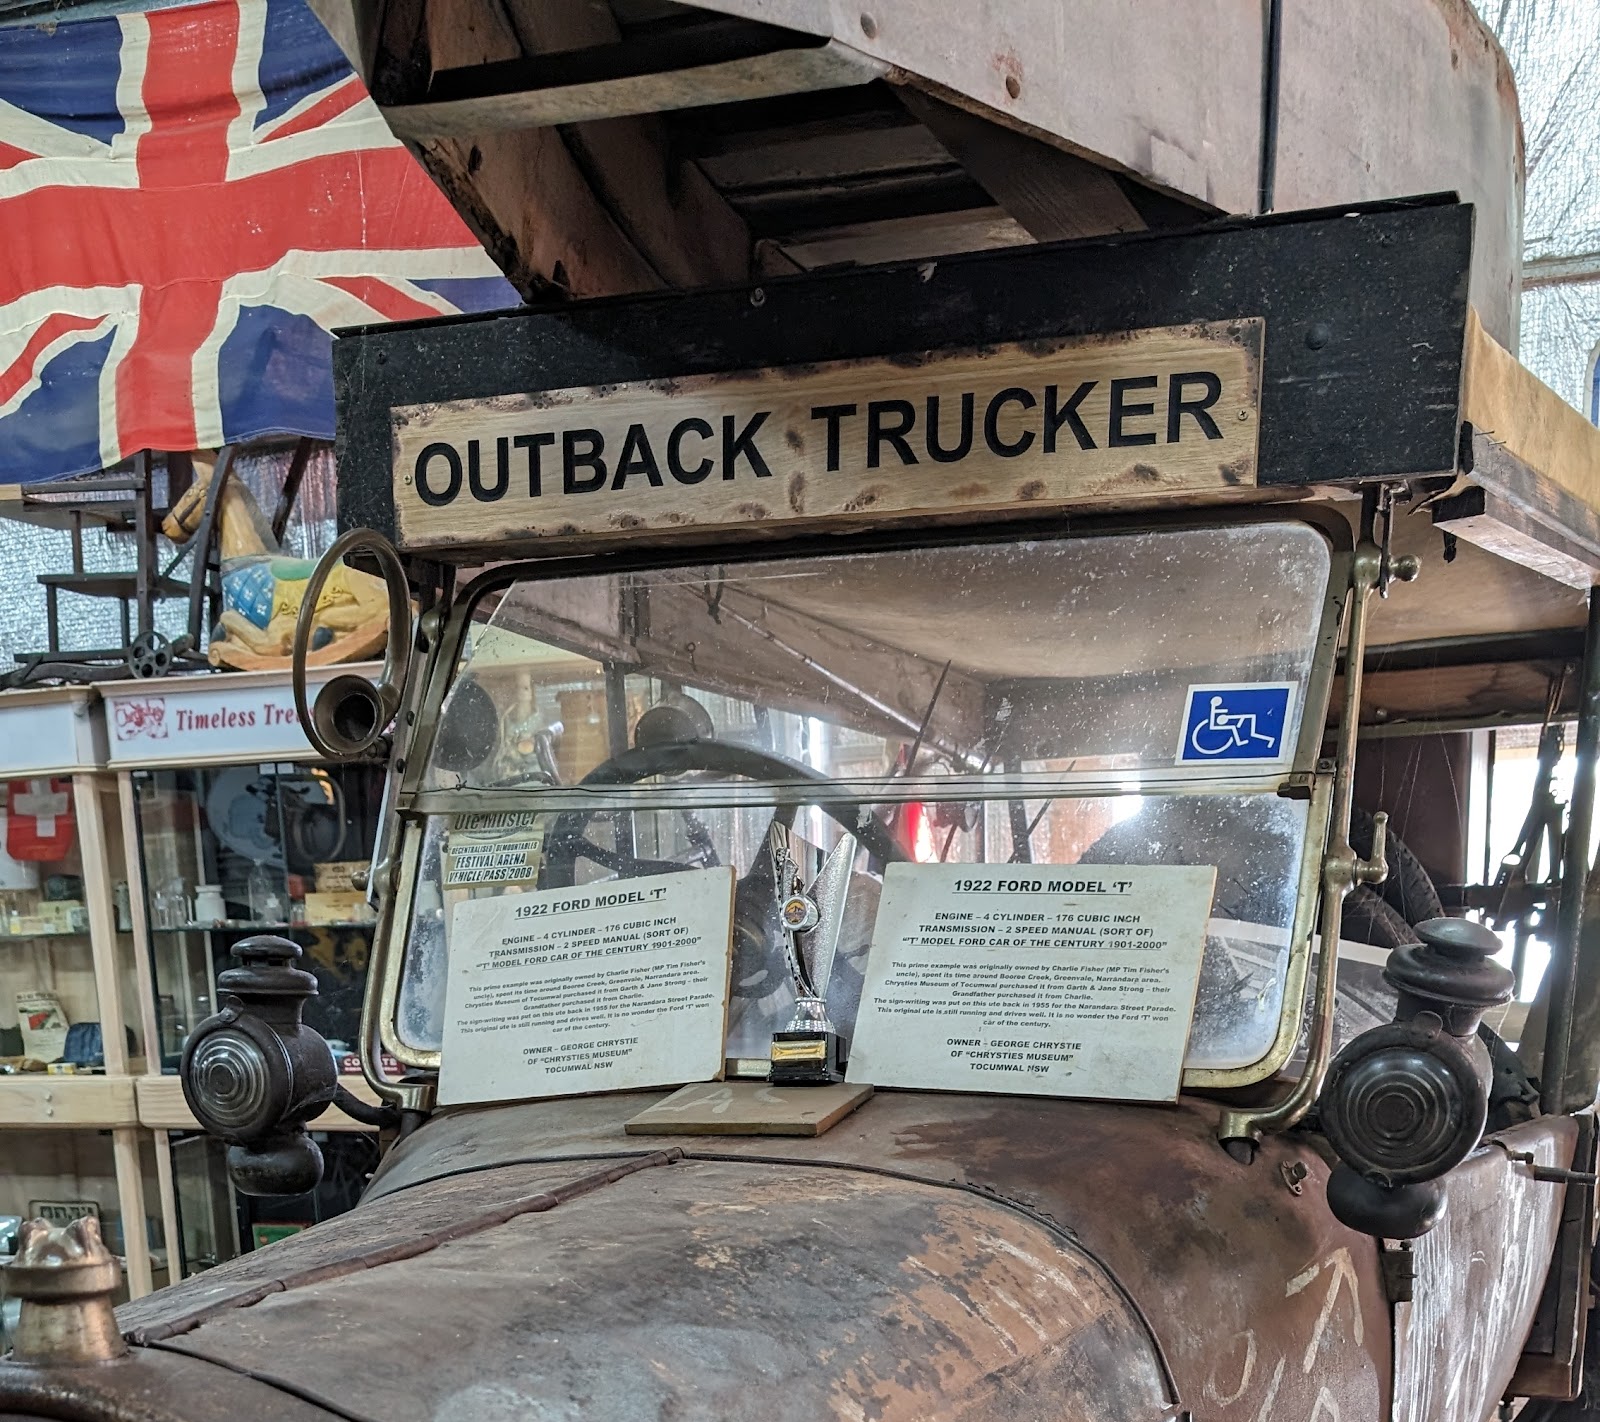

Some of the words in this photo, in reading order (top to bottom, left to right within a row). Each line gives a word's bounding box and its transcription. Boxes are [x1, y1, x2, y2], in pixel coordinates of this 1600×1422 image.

[414, 410, 773, 508] OUTBACK
[811, 371, 1225, 473] TRUCKER
[175, 707, 256, 731] Timeless
[456, 854, 495, 868] FESTIVAL
[497, 853, 526, 866] ARENA
[449, 870, 482, 882] VEHICLE
[483, 868, 507, 880] PASS
[508, 866, 533, 879] 2008
[953, 879, 993, 891] 1922
[997, 880, 1043, 892] FORD
[1047, 880, 1108, 893] MODEL
[515, 903, 548, 918] 1922
[552, 897, 591, 913] FORD
[595, 890, 646, 907] MODEL
[935, 912, 973, 920] ENGINE
[992, 913, 1045, 921] CYLINDER
[1055, 914, 1074, 922] 176
[1076, 914, 1112, 922] CUBIC
[1113, 914, 1140, 923] INCH
[501, 934, 535, 946] ENGINE
[550, 927, 596, 939] CYLINDER
[604, 923, 621, 932] 176
[622, 919, 652, 930] CUBIC
[653, 916, 676, 927] INCH
[918, 924, 995, 934] TRANSMISSION
[1013, 926, 1049, 934] SPEED
[1051, 926, 1097, 936] MANUAL
[1099, 927, 1133, 937] (SORT
[1135, 928, 1154, 937] OF)
[488, 943, 555, 959] TRANSMISSION
[563, 941, 569, 949] 2
[571, 938, 600, 948] SPEED
[602, 932, 642, 944] MANUAL
[642, 928, 672, 940] (SORT
[673, 926, 689, 936] OF)
[920, 936, 957, 945] MODEL
[958, 937, 987, 946] FORD
[988, 938, 1010, 946] CAR
[1012, 938, 1029, 947] OF
[1028, 939, 1051, 947] THE
[1053, 939, 1105, 948] CENTURY
[491, 958, 522, 968] MODEL
[524, 955, 548, 964] FORD
[549, 953, 569, 961] CAR
[570, 951, 583, 959] OF
[584, 948, 603, 957] THE
[604, 943, 649, 955] CENTURY
[522, 1046, 553, 1055] OWNER
[560, 1041, 594, 1051] GEORGE
[596, 1037, 638, 1047] CHRYSTIE
[946, 1038, 981, 1046] OWNER
[990, 1039, 1030, 1048] GEORGE
[1031, 1040, 1081, 1050] CHRYSTIE
[343, 1057, 398, 1067] COTE
[544, 1063, 593, 1074] TOCUMWAL
[593, 1061, 613, 1069] NSW
[969, 1062, 1025, 1072] TOCUMWAL
[1027, 1064, 1049, 1073] NSW
